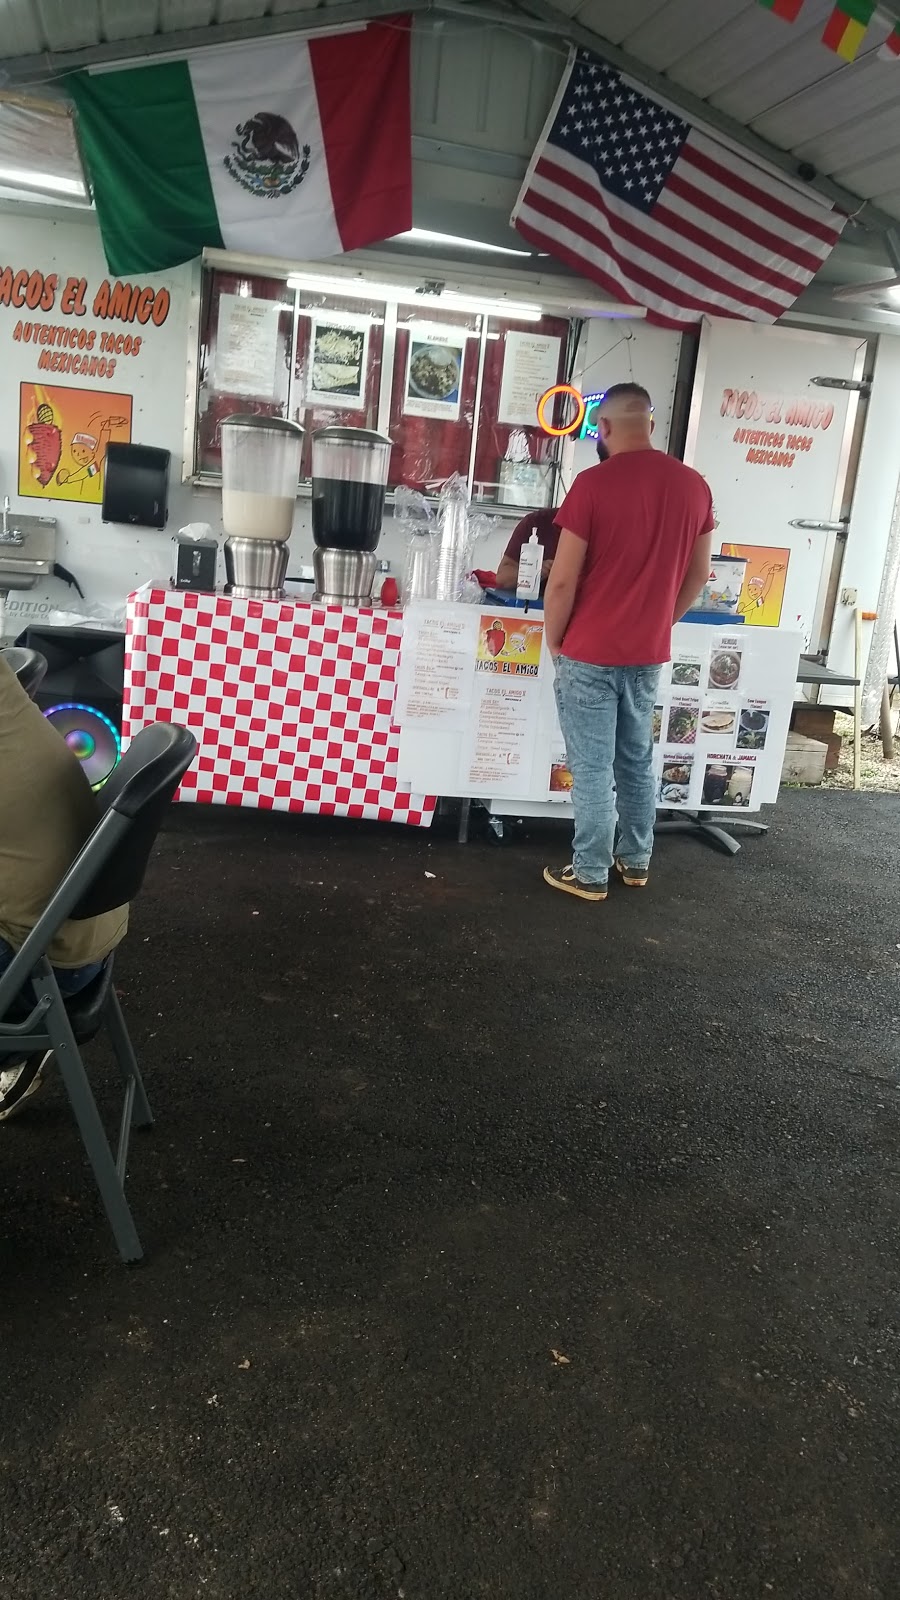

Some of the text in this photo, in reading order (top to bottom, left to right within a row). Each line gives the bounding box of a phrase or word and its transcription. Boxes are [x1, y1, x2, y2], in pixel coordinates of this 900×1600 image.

[0, 267, 170, 326] ACOS EL AMIGO
[13, 320, 142, 356] AUTENTICOS TACOS
[38, 349, 117, 379] MEXICANOS
[720, 388, 834, 431] TACOS EL AMIGO
[733, 427, 813, 452] AUTENTICOS TACOS
[746, 447, 796, 468] MEXICANOS
[475, 660, 498, 673] TACOS
[503, 662, 511, 673] EL
[706, 753, 732, 761] HORCHATA
